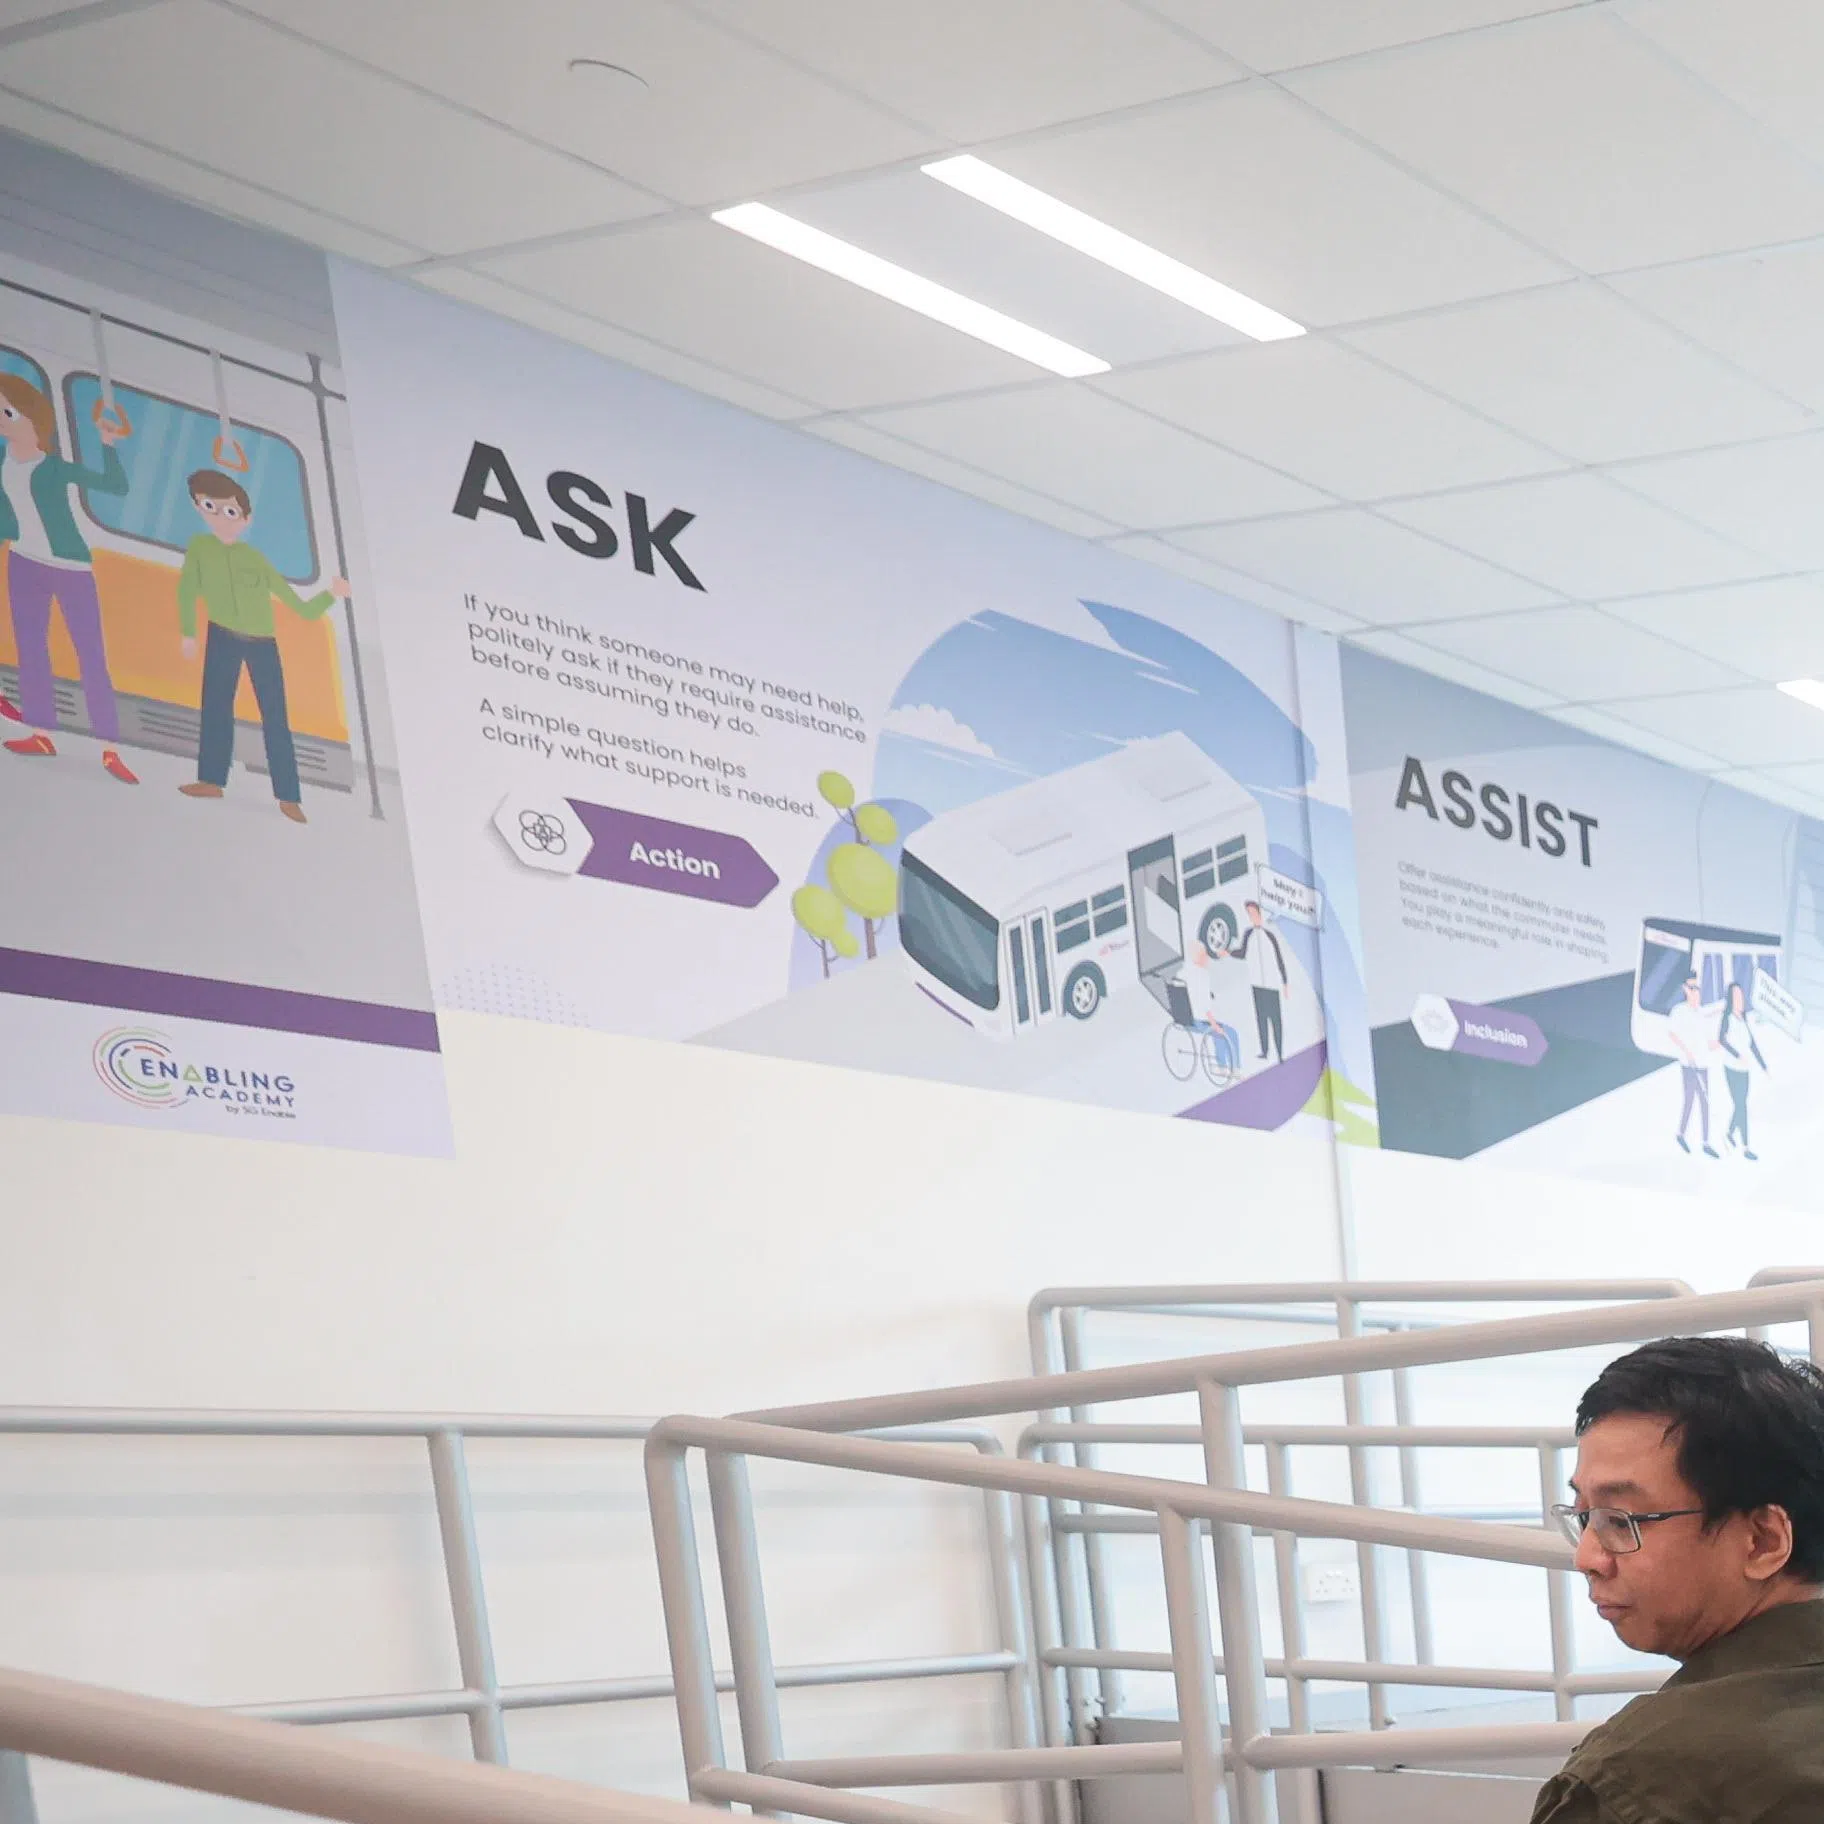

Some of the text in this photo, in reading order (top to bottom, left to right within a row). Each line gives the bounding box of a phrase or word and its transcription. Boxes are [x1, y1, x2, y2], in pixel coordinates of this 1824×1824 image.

[452, 440, 707, 593] ASK
[464, 593, 864, 722] If you think someone may need help,
[468, 622, 866, 743] politely ask if they require assistance
[471, 645, 759, 736] before assuming they do.
[480, 698, 746, 778] A simple question helps
[482, 725, 819, 818] clarify what support is needed.
[1396, 756, 1598, 867] ASSIST
[630, 841, 720, 879] Action
[141, 1058, 294, 1092] ENABLING
[1464, 1020, 1528, 1048] Inclusion
[186, 1085, 294, 1107] ACADEMY
